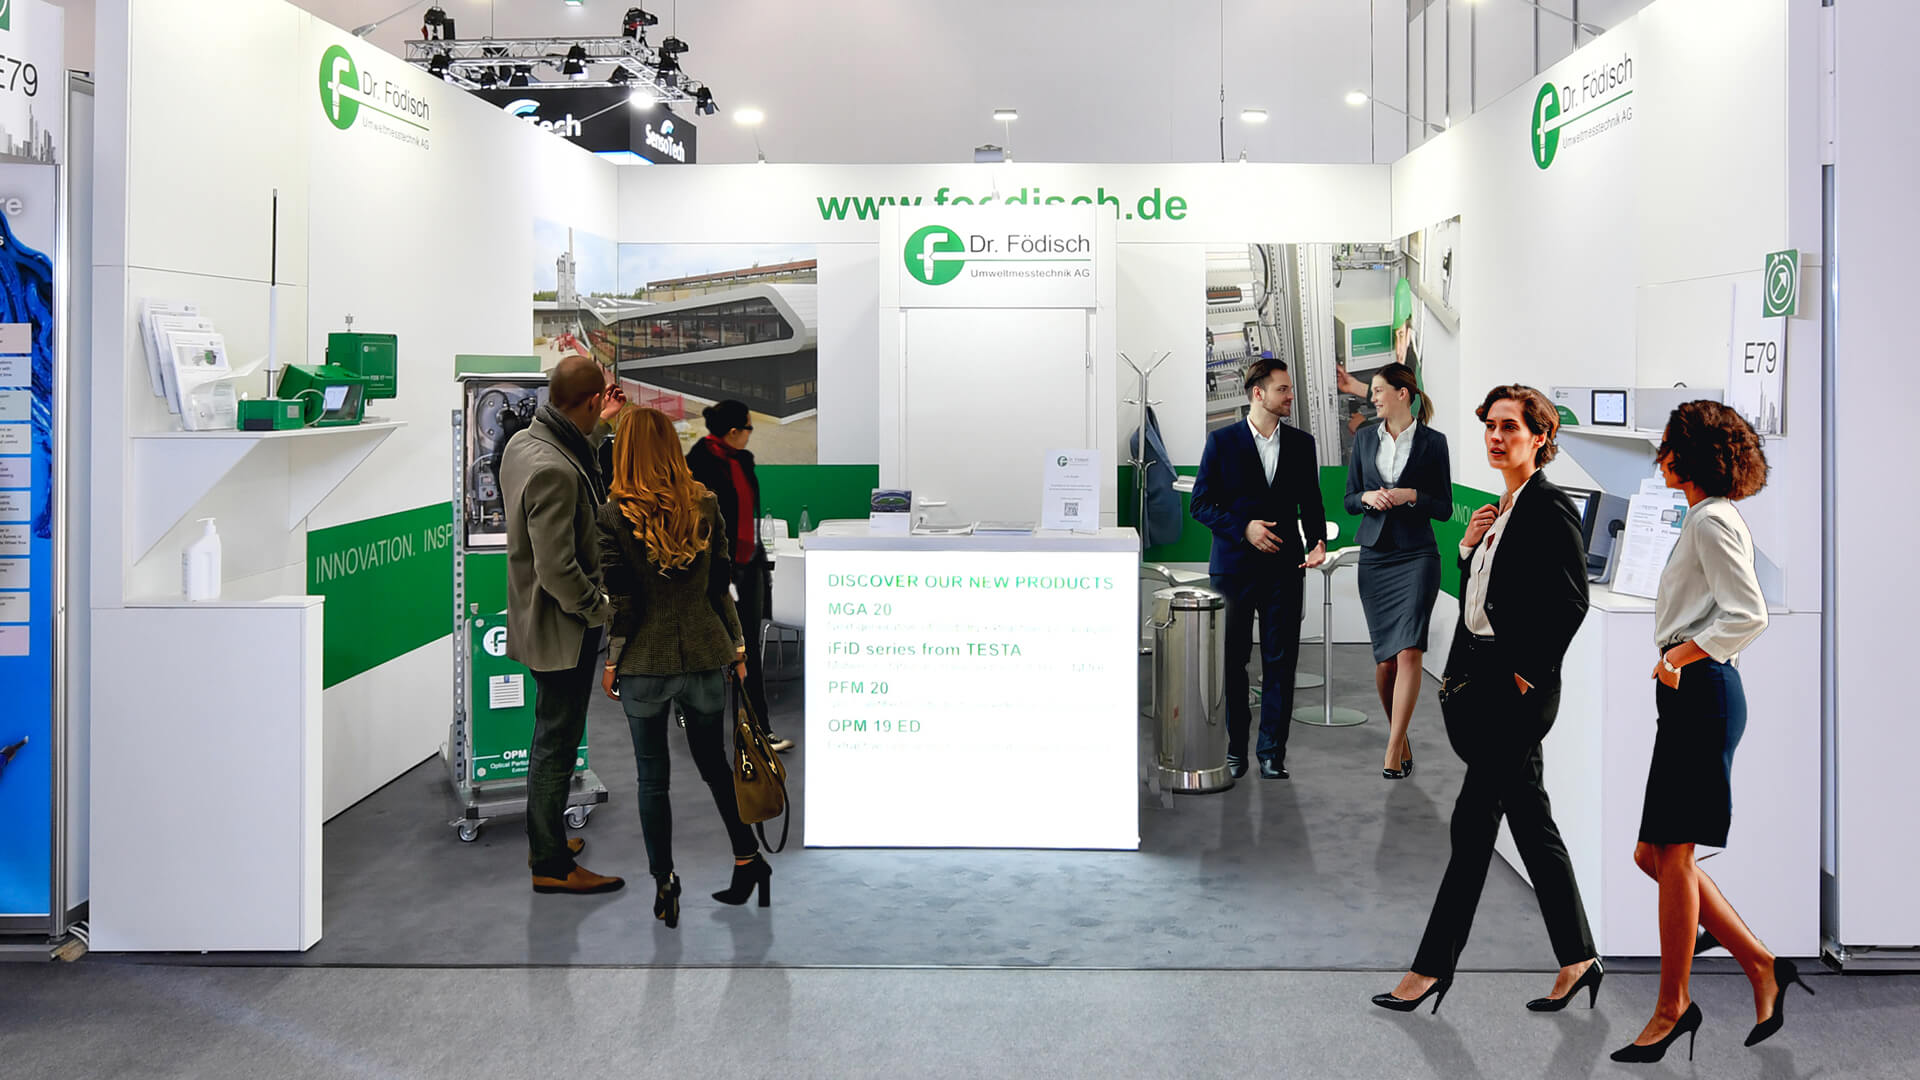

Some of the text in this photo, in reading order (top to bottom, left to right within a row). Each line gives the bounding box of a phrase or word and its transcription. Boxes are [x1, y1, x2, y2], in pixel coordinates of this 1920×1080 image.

[1562, 52, 1633, 114] Dr. Födisch
[363, 71, 430, 121] Dr. Födisch
[645, 123, 685, 163] SensoTech
[970, 234, 1091, 253] Dr. Födisch
[970, 268, 1091, 279] Umweltmesstechnik AG
[1744, 341, 1778, 375] E79
[315, 533, 417, 584] INNOVATION.
[828, 574, 1114, 590] DISCOVER OUR NEW PRODUCTS
[828, 602, 893, 616] MGA 20
[828, 641, 1022, 657] iFiD series from TESTA
[828, 681, 889, 695] PFM 20
[828, 719, 921, 732] OPM 19 ED
[503, 749, 528, 760] OPM
